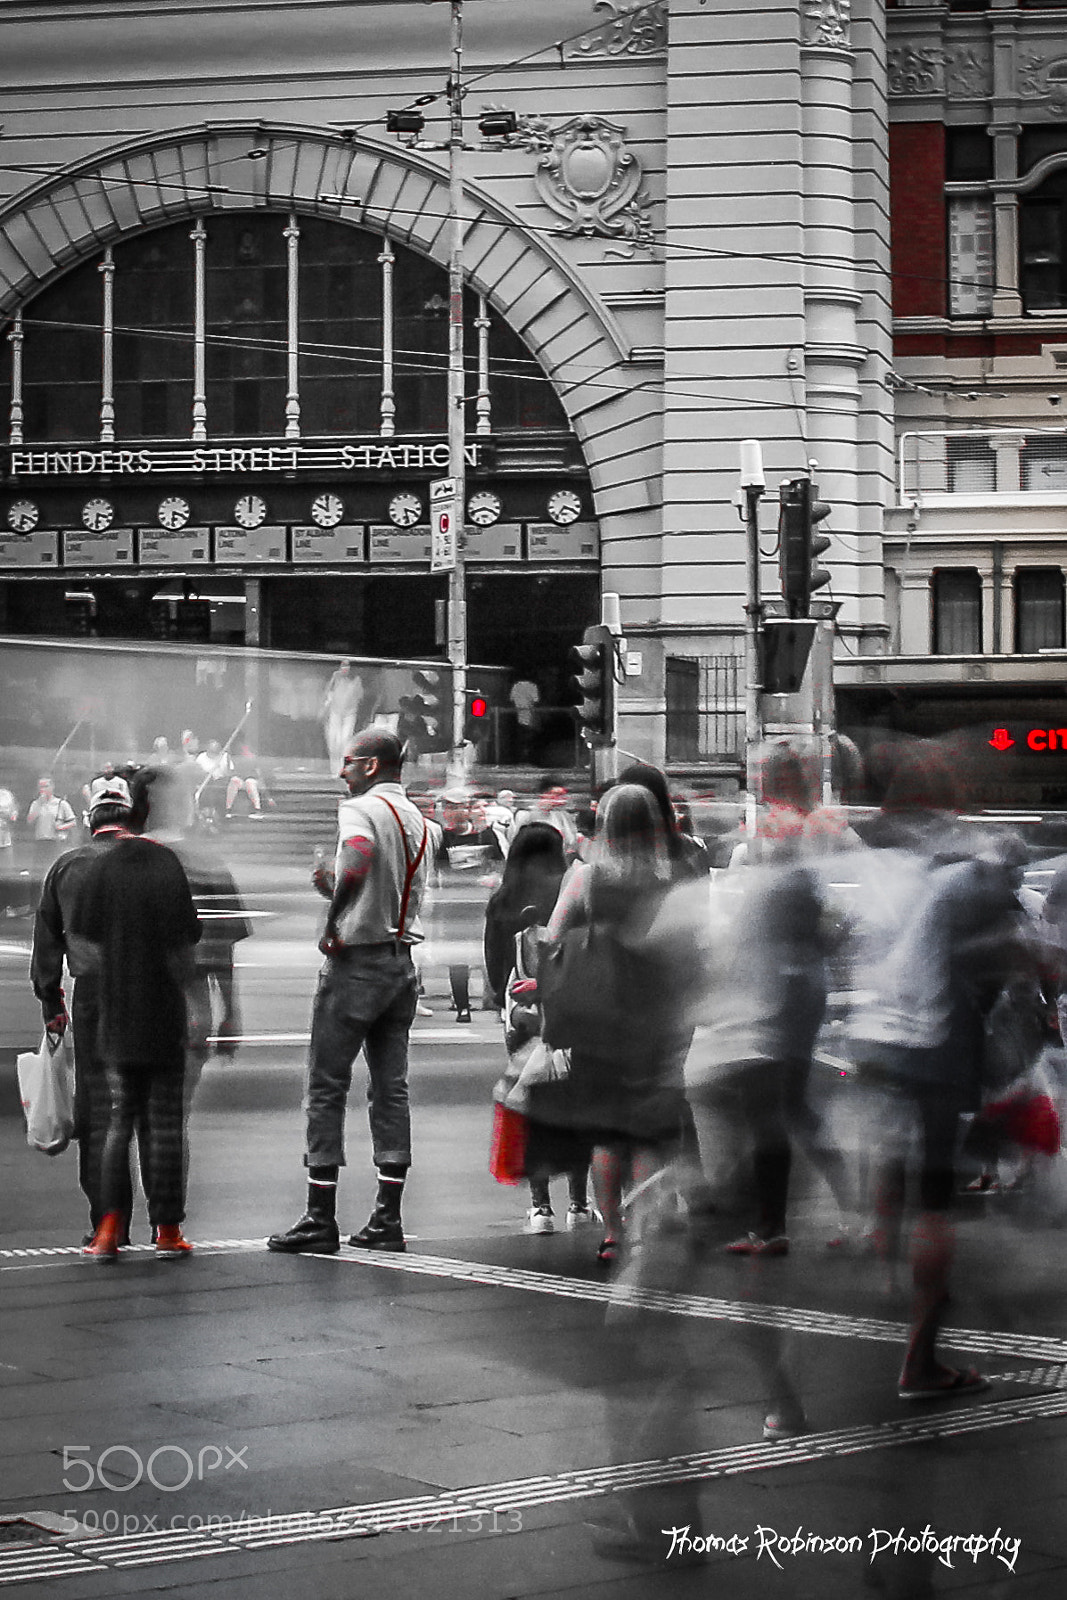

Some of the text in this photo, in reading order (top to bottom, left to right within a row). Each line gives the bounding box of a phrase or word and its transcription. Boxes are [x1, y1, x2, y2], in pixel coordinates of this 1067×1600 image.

[11, 443, 478, 475] FLINDERS STREET STATION
